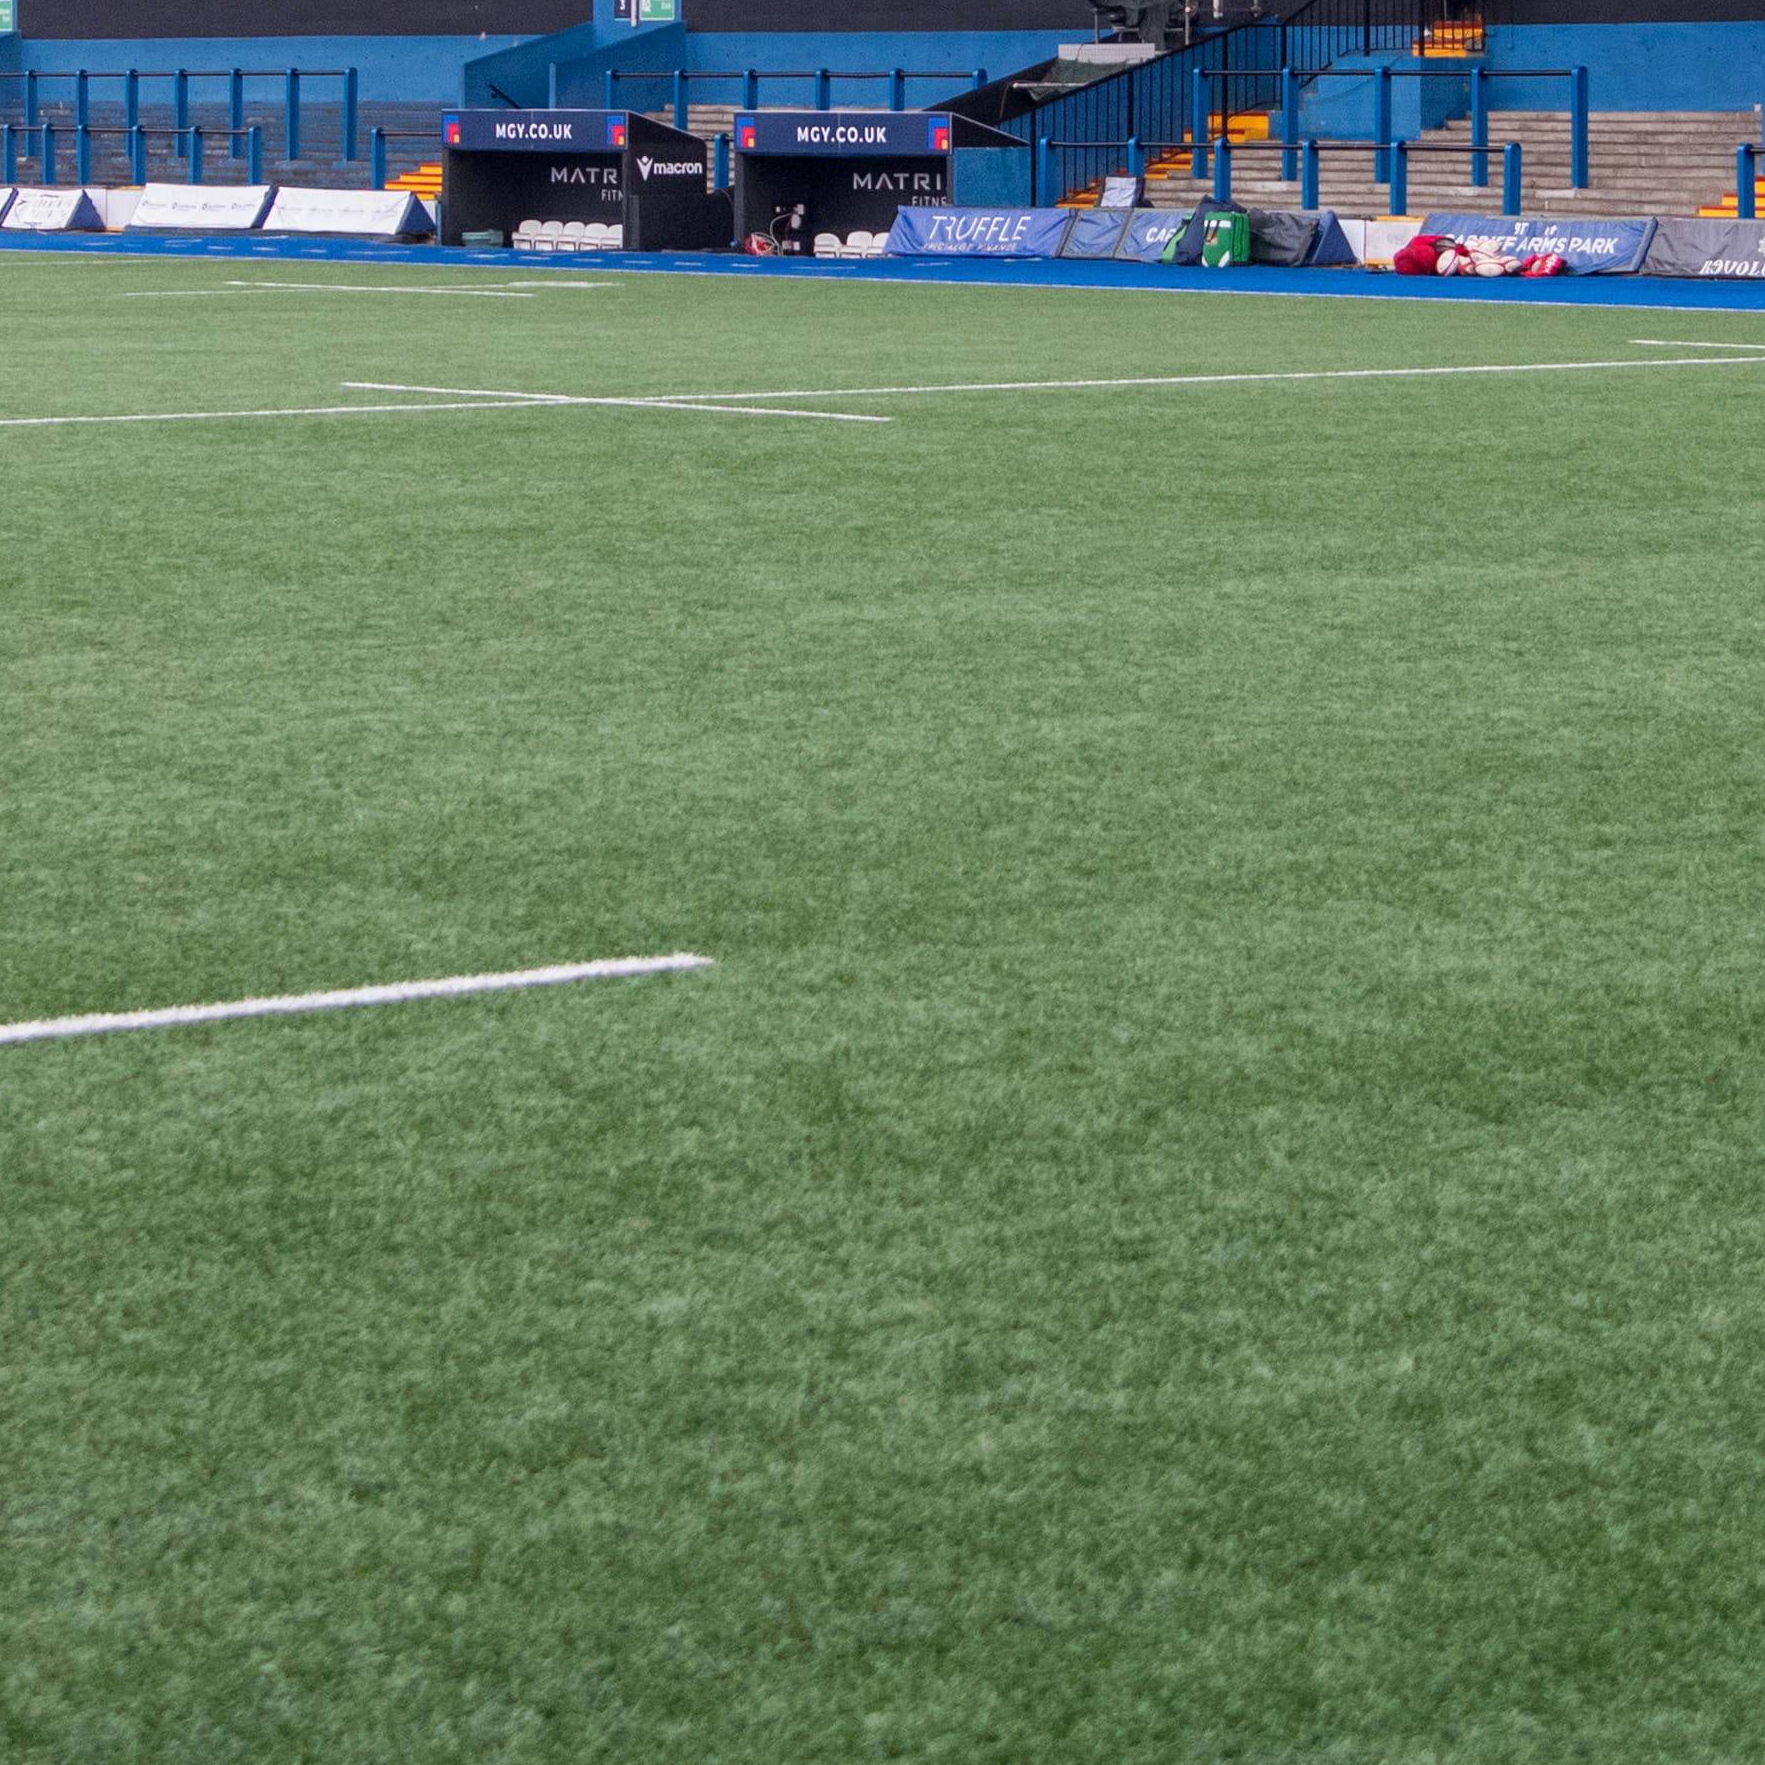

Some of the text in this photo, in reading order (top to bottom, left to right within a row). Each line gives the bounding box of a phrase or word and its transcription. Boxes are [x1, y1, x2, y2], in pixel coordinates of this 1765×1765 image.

[496, 124, 573, 140] MGY.CO.UK
[796, 126, 886, 144] MGY.CO.UK
[653, 162, 703, 175] macron
[927, 215, 1031, 242] TRUFFLE
[1518, 235, 1567, 253] ARMS
[1569, 238, 1618, 254] PARK
